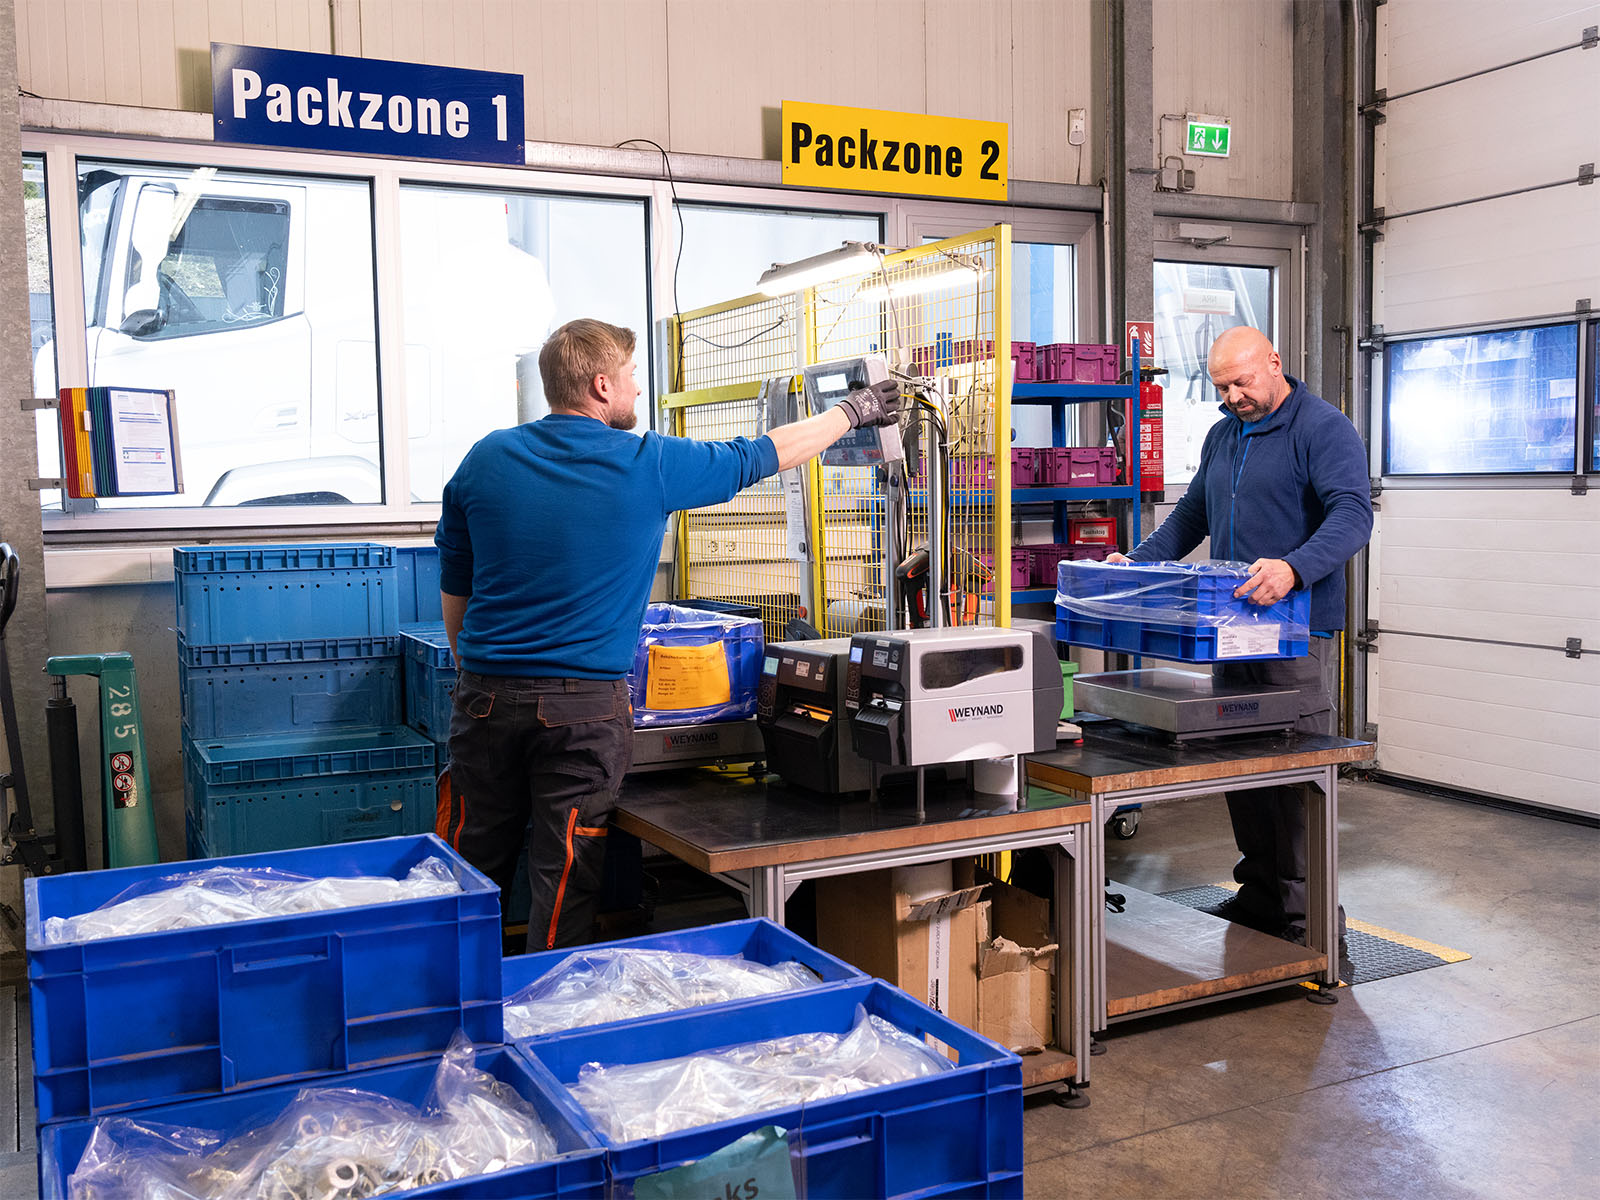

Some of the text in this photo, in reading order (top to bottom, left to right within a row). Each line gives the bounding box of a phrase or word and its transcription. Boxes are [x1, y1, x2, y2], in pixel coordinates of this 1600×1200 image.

[232, 68, 508, 142] Packzone 1
[791, 121, 1000, 181] Packzone 2
[108, 685, 137, 739] 285
[954, 704, 1004, 718] WEYNAND
[1222, 702, 1259, 713] WEYNAND
[671, 732, 718, 745] WEYNAND
[712, 1177, 760, 1200] ks
